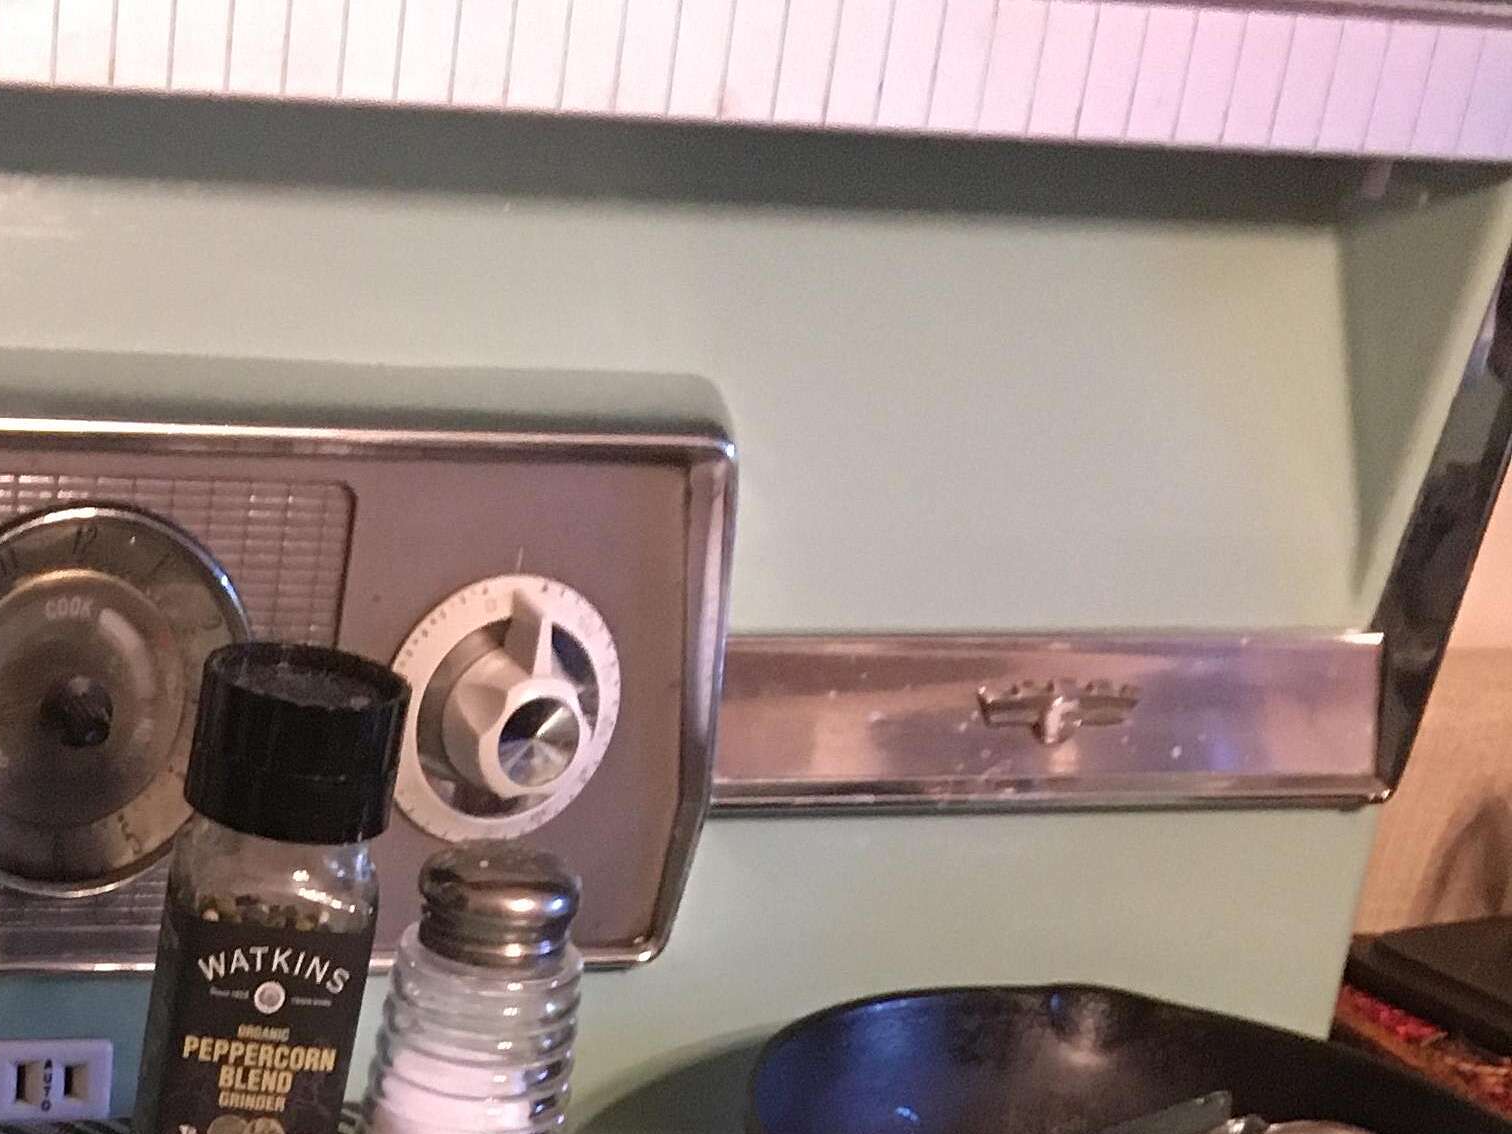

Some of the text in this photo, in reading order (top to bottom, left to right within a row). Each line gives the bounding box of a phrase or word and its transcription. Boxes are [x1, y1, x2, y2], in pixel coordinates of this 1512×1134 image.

[44, 596, 94, 620] COOK
[197, 945, 350, 995] WATKINS
[238, 1023, 290, 1042] ORGANIC
[182, 1034, 337, 1072] PEPPERCORN
[40, 1058, 54, 1112] AUTO
[218, 1064, 295, 1094] BLEND
[218, 1091, 287, 1112] GRINDER
